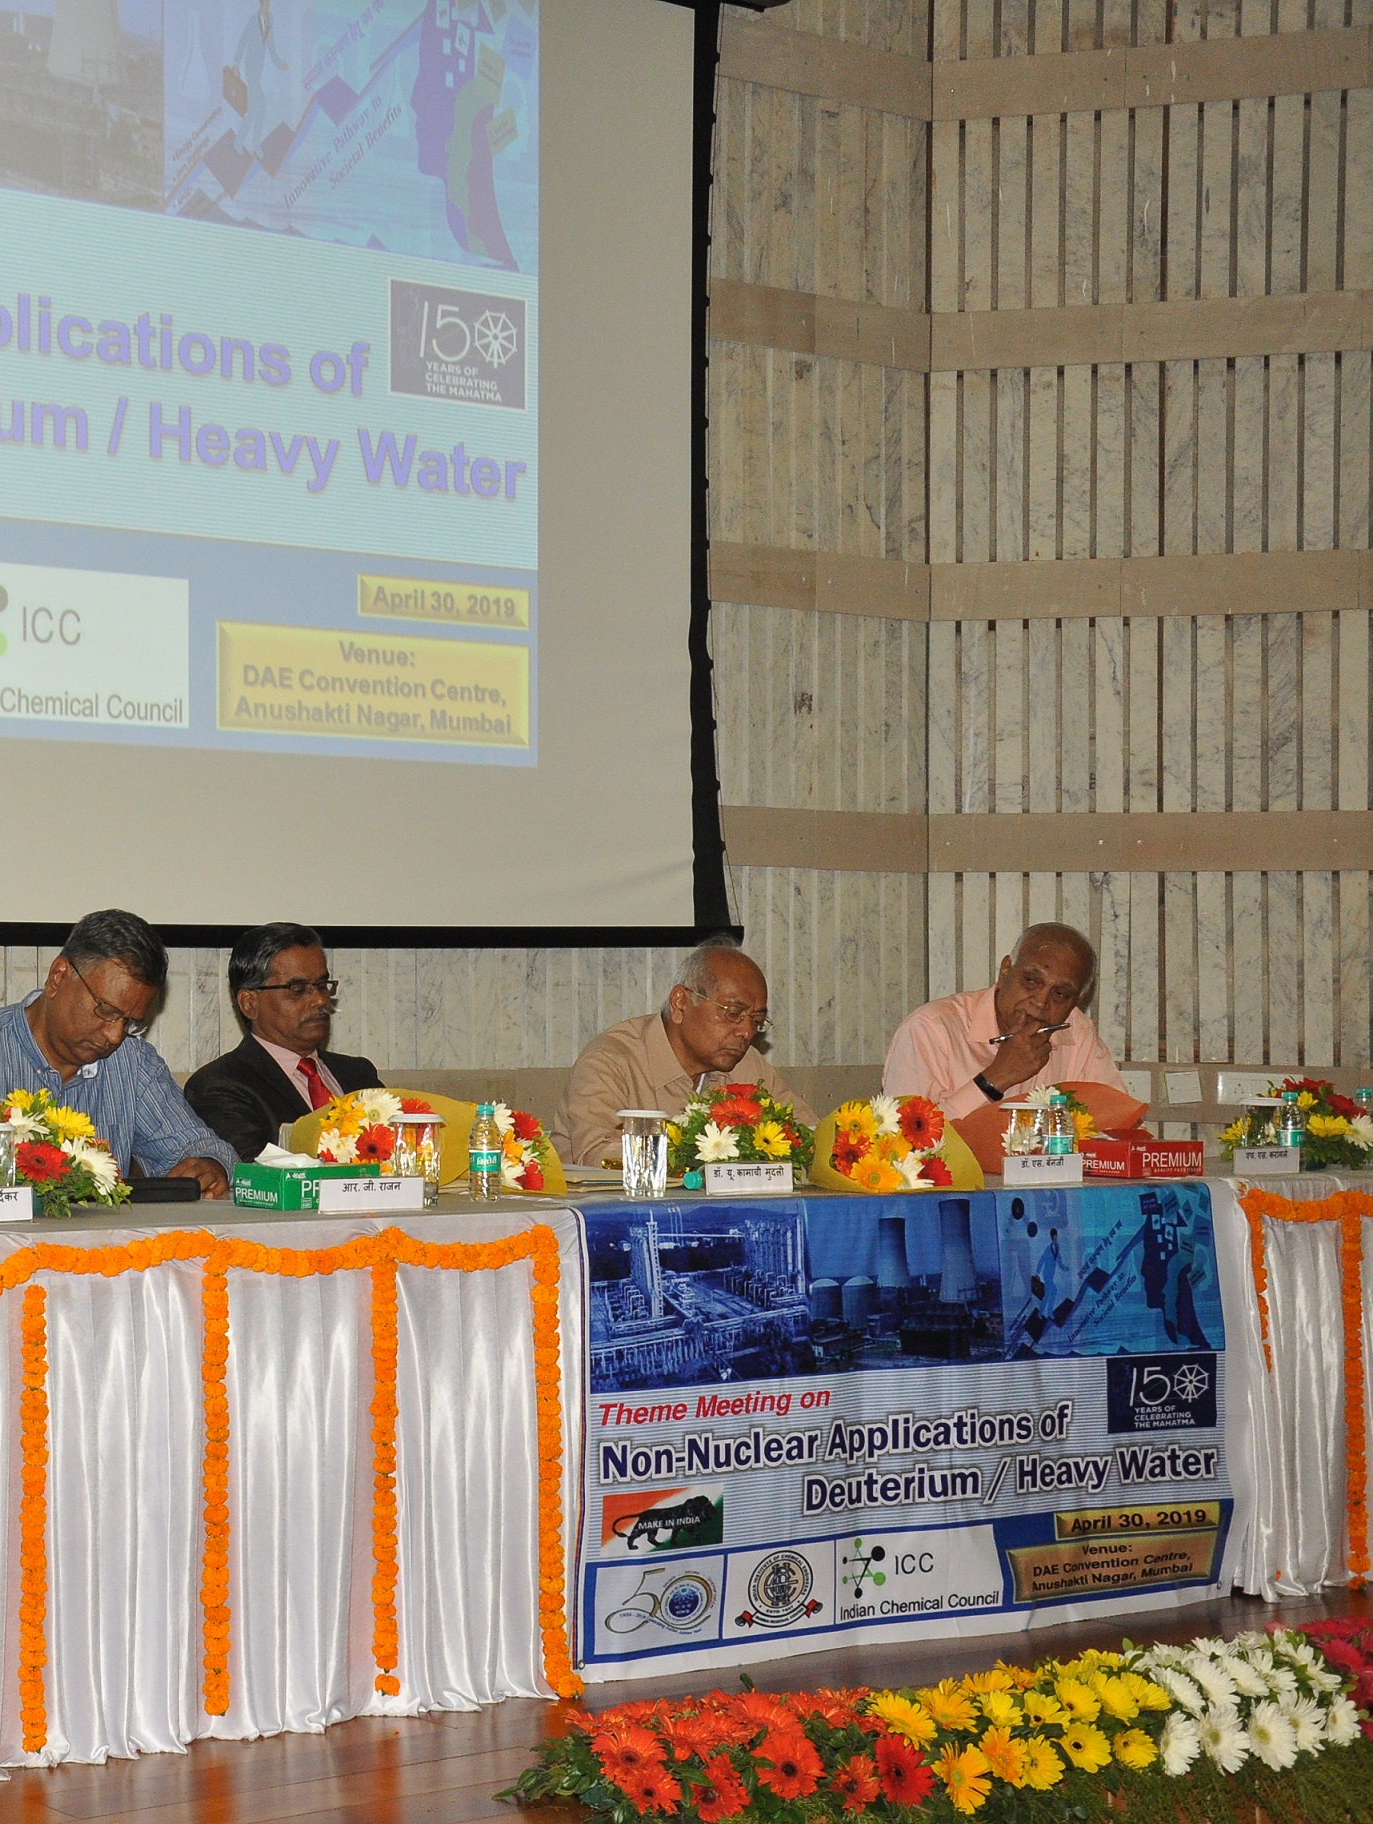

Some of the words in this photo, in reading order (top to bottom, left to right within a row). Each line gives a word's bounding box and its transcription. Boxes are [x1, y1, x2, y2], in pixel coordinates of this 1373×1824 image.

[309, 341, 371, 397] of
[425, 360, 462, 376] YEARS
[464, 366, 479, 376] OF
[425, 371, 498, 392] CELEBRATING
[426, 382, 447, 395] THE
[449, 386, 503, 403] MAHATMA
[148, 402, 341, 493] Heavy
[356, 428, 528, 500] Water
[372, 583, 427, 615] April
[429, 588, 462, 616] 30,
[466, 591, 517, 619] 2019
[21, 606, 82, 647] ICC
[338, 641, 416, 668] Venue:
[241, 664, 294, 691] DAE
[298, 669, 427, 701] Convention
[430, 681, 508, 708] Centre,
[106, 694, 184, 724] Council
[234, 695, 351, 725] Anushakti
[356, 705, 427, 736] Nagar,
[429, 709, 513, 737] Mumbai
[713, 1166, 723, 1178] डॉ.
[1081, 1158, 1125, 1171] PREMIUM
[1141, 1152, 1202, 1168] PREMIUM
[235, 1187, 278, 1203] PREMIUM
[341, 1182, 360, 1193] आर.
[363, 1181, 377, 1192] जी.
[379, 1180, 402, 1191] राजन
[598, 1401, 688, 1426] Theme
[695, 1391, 792, 1419] Meeting
[799, 1389, 832, 1408] on
[1133, 1411, 1192, 1422] CELEBRATING
[1134, 1406, 1162, 1415] YEARS
[1164, 1404, 1176, 1412] OF
[1133, 1421, 1151, 1429] THE
[1152, 1418, 1196, 1428] MAHATMA
[601, 1430, 821, 1481] Non-Nuclear
[826, 1410, 1033, 1461] Applications
[1040, 1402, 1071, 1440] of
[805, 1465, 980, 1512] Deuterium
[986, 1460, 1008, 1503] /
[1018, 1456, 1110, 1492] Heavy
[1118, 1447, 1216, 1480] Water
[637, 1519, 664, 1530] MAKE
[665, 1518, 675, 1528] IN
[676, 1515, 701, 1527] INDIA
[1071, 1515, 1113, 1534] April
[1118, 1513, 1152, 1530] 30,
[1156, 1508, 1208, 1527] 2019
[1082, 1542, 1134, 1557] Venue:
[894, 1552, 935, 1576] ICC
[1032, 1563, 1061, 1578] DAE
[1062, 1556, 1140, 1575] Convention
[1142, 1549, 1192, 1566] Centre,
[1031, 1575, 1090, 1593] Anushakti
[1092, 1569, 1138, 1587] Nagar,
[1140, 1562, 1194, 1580] Mumbai
[839, 1600, 877, 1622] Indian
[879, 1595, 944, 1616] Chemical
[947, 1590, 1001, 1611] Council
